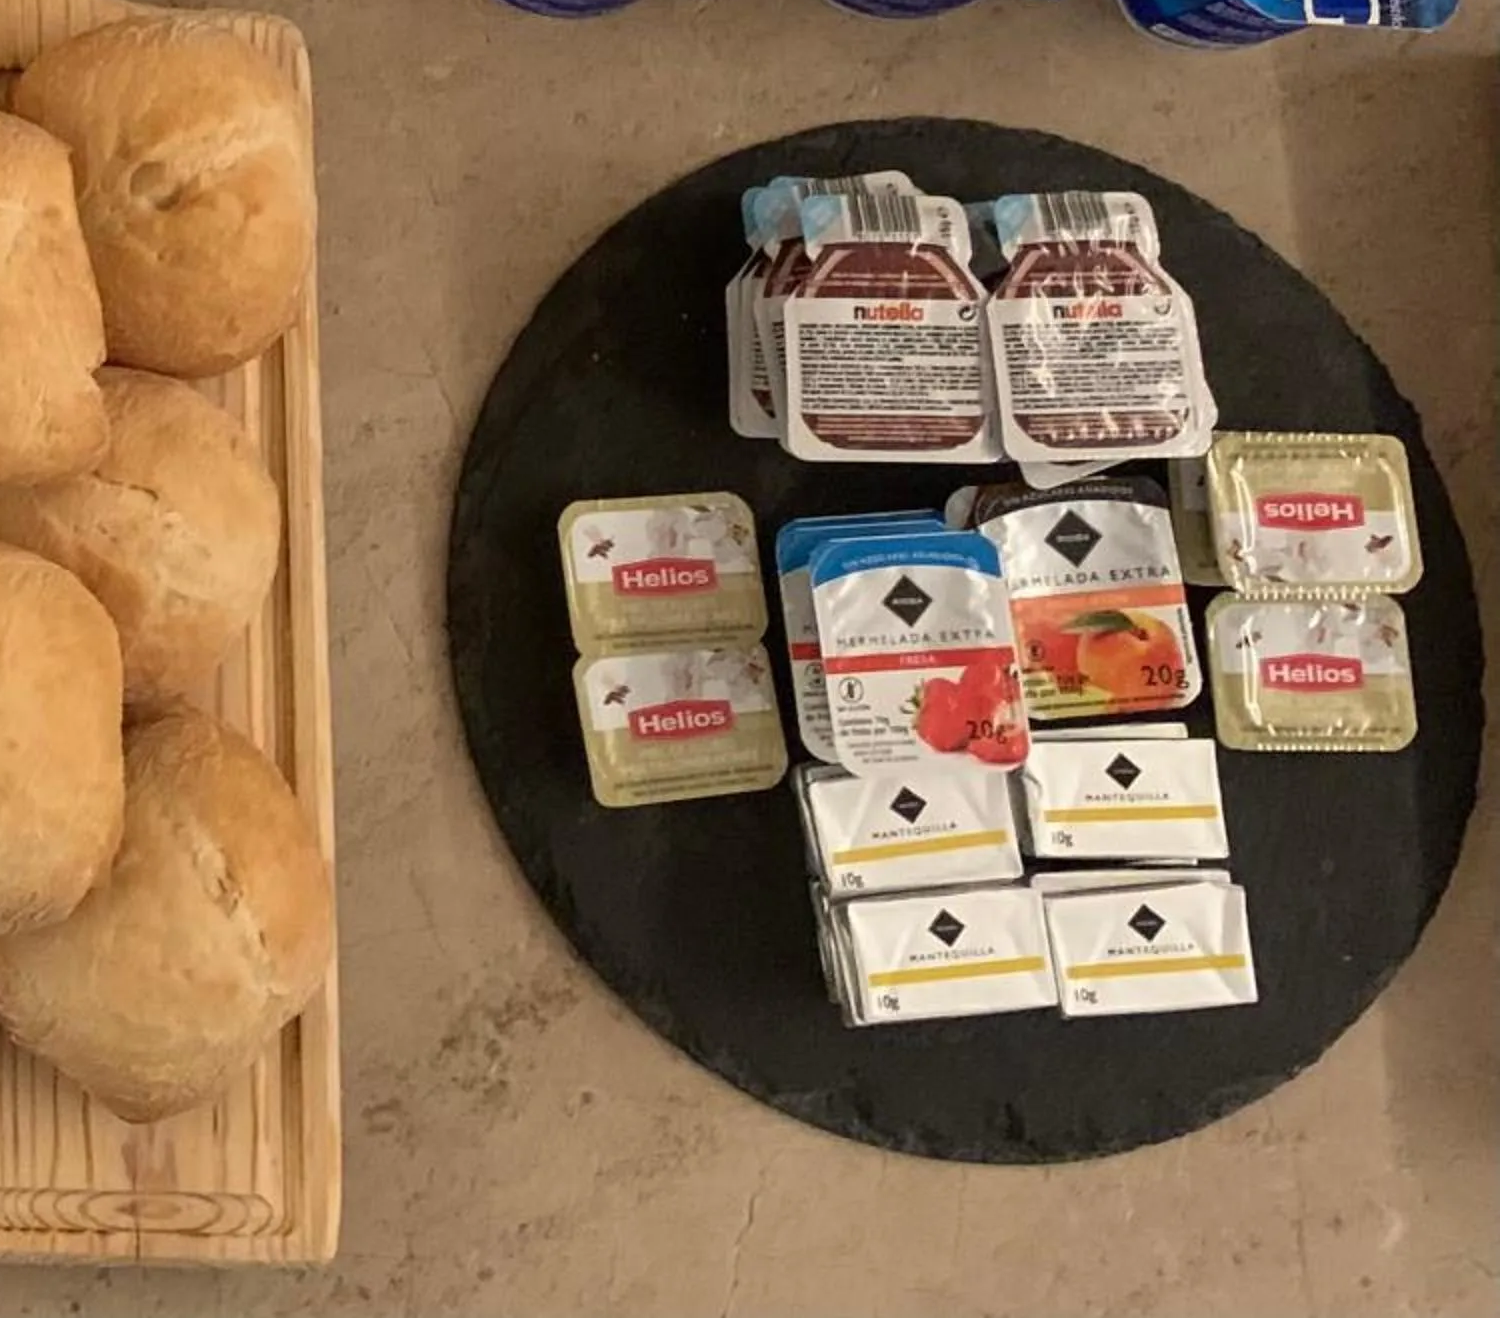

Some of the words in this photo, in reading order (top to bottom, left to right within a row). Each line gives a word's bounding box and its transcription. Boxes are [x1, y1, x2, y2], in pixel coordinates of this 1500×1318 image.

[854, 303, 924, 322] nutella
[1053, 301, 1124, 319] nutlla
[1264, 502, 1355, 521] Helios
[621, 567, 709, 589] Helios
[1109, 565, 1171, 581] EXTRA
[836, 632, 932, 648] MERMELADA
[938, 629, 995, 643] EXTRA
[1140, 664, 1190, 689] 20g
[1268, 663, 1356, 684] Helios
[638, 710, 726, 735] Helios
[909, 947, 996, 962] MANTEQUILLA
